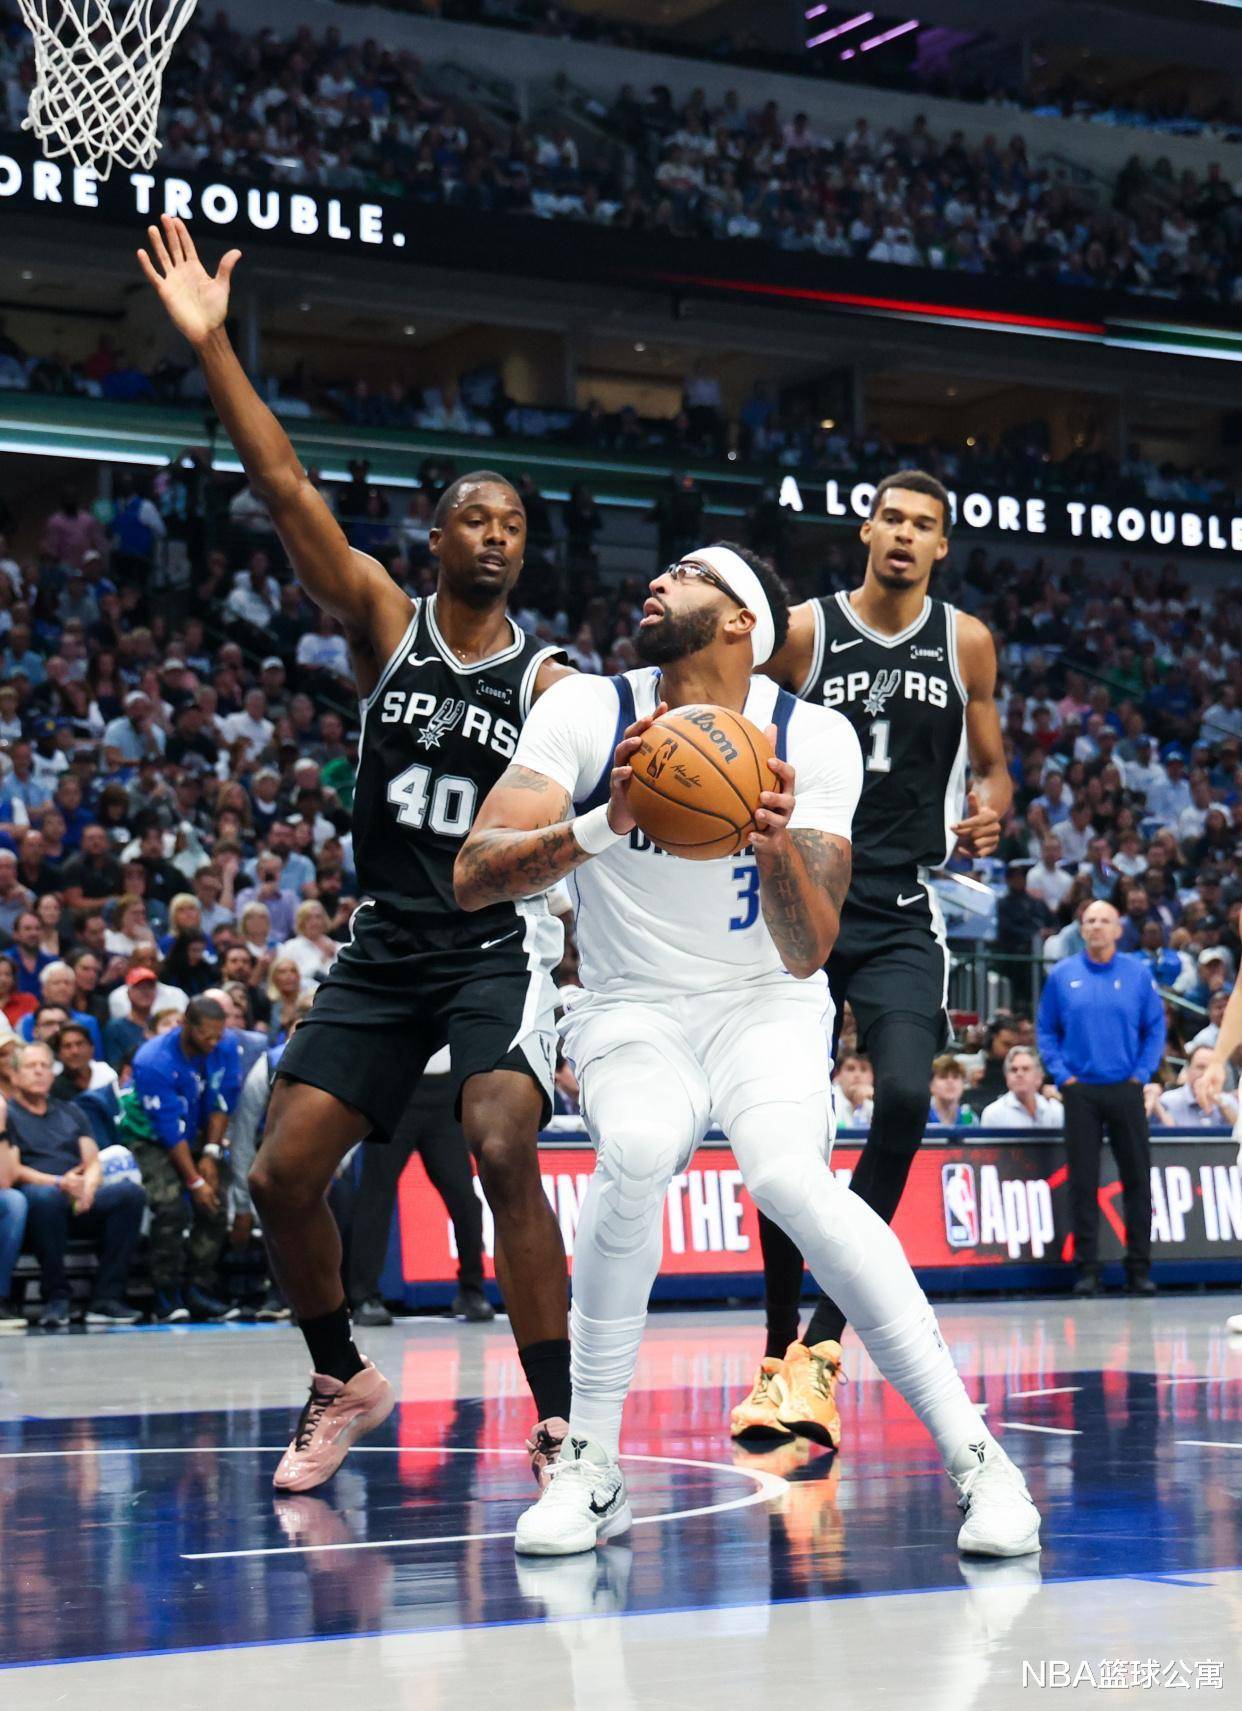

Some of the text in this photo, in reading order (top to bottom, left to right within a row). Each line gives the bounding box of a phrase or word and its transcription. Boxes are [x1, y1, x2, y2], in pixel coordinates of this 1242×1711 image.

[130, 173, 405, 247] TROUBLE.
[779, 475, 804, 511] A
[827, 479, 878, 518] LO
[381, 691, 518, 759] SPURS
[823, 669, 949, 717] SPURS
[866, 720, 892, 772] 1
[387, 763, 478, 838] 40
[727, 865, 761, 932] 3
[667, 1170, 750, 1254] THE
[980, 1164, 1055, 1259] App
[1149, 1166, 1194, 1242] AP
